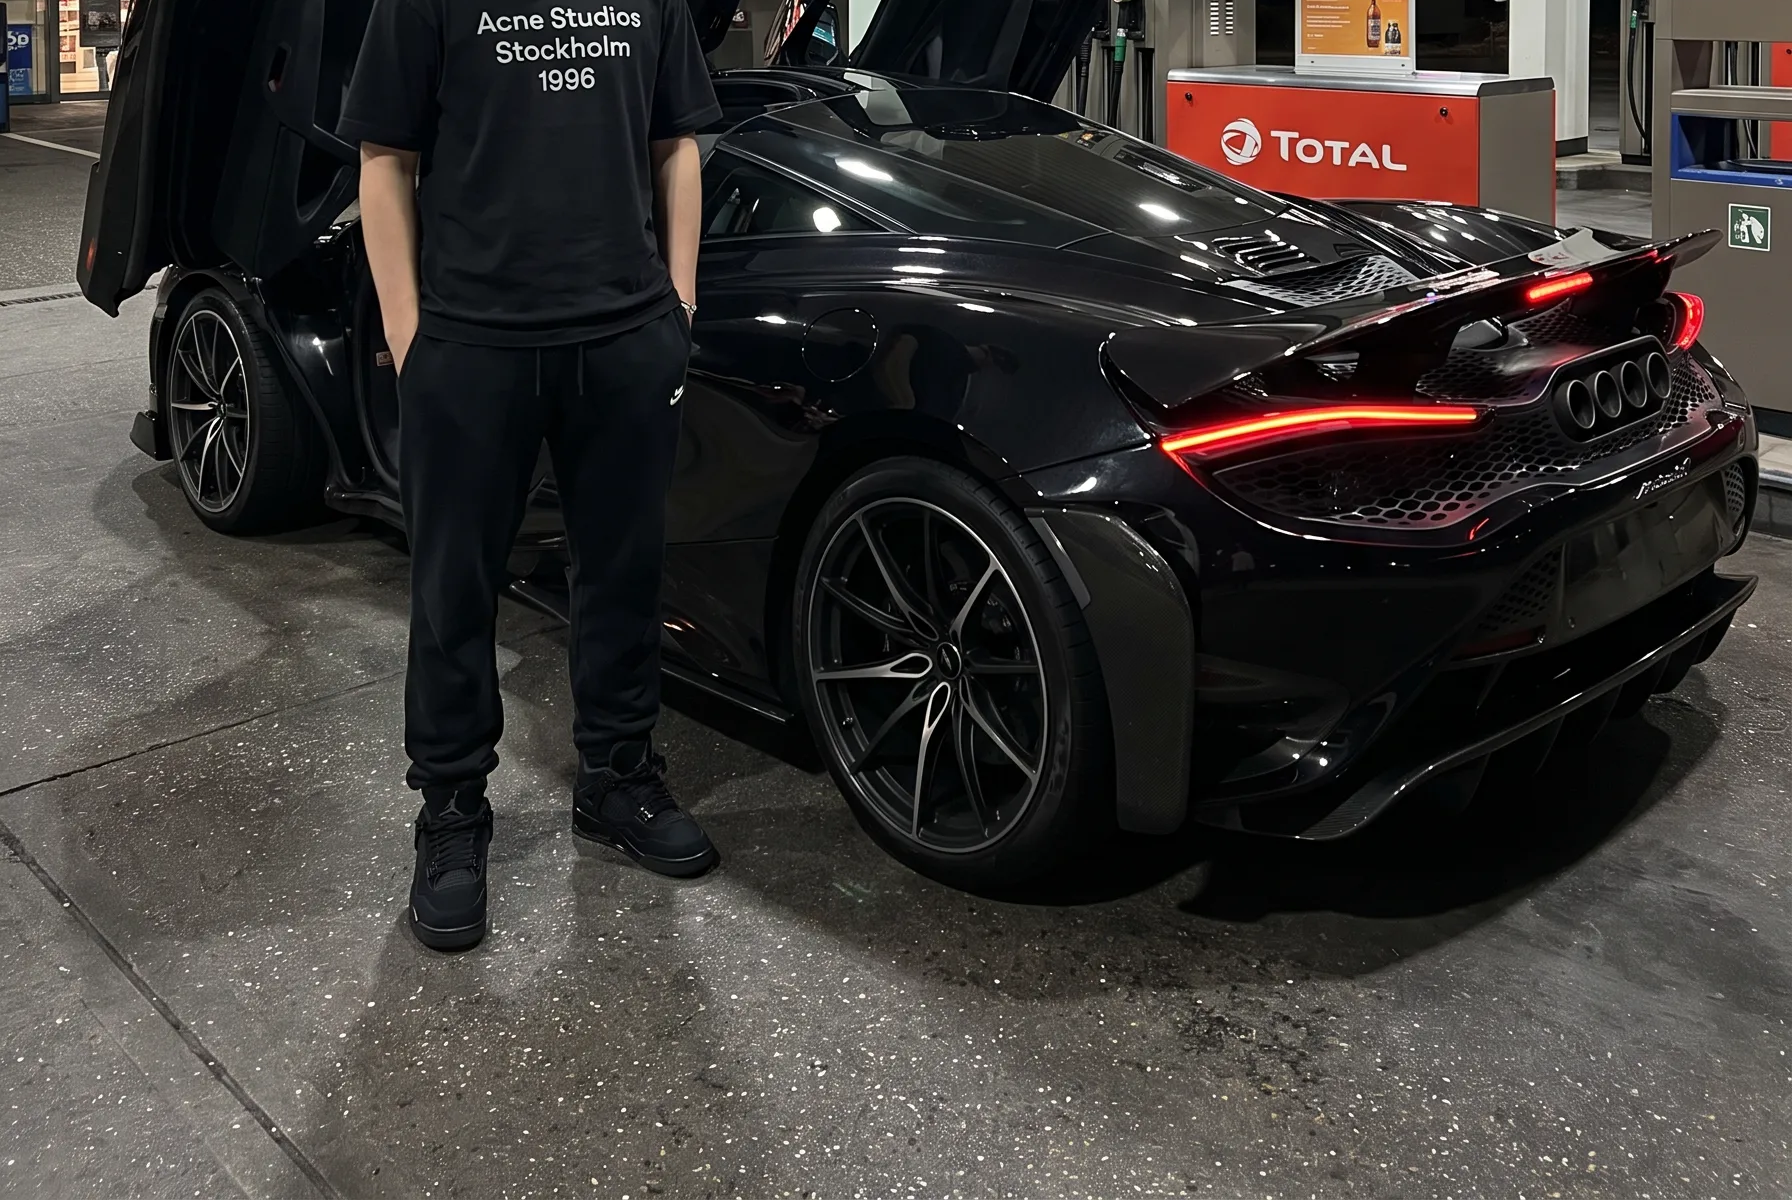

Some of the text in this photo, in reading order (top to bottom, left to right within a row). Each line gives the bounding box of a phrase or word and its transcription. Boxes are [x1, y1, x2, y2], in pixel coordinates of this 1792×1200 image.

[477, 5, 642, 35] Acne Studios
[495, 35, 631, 64] Stockholm
[538, 67, 596, 92] 1996
[1270, 130, 1408, 171] TOTAL
